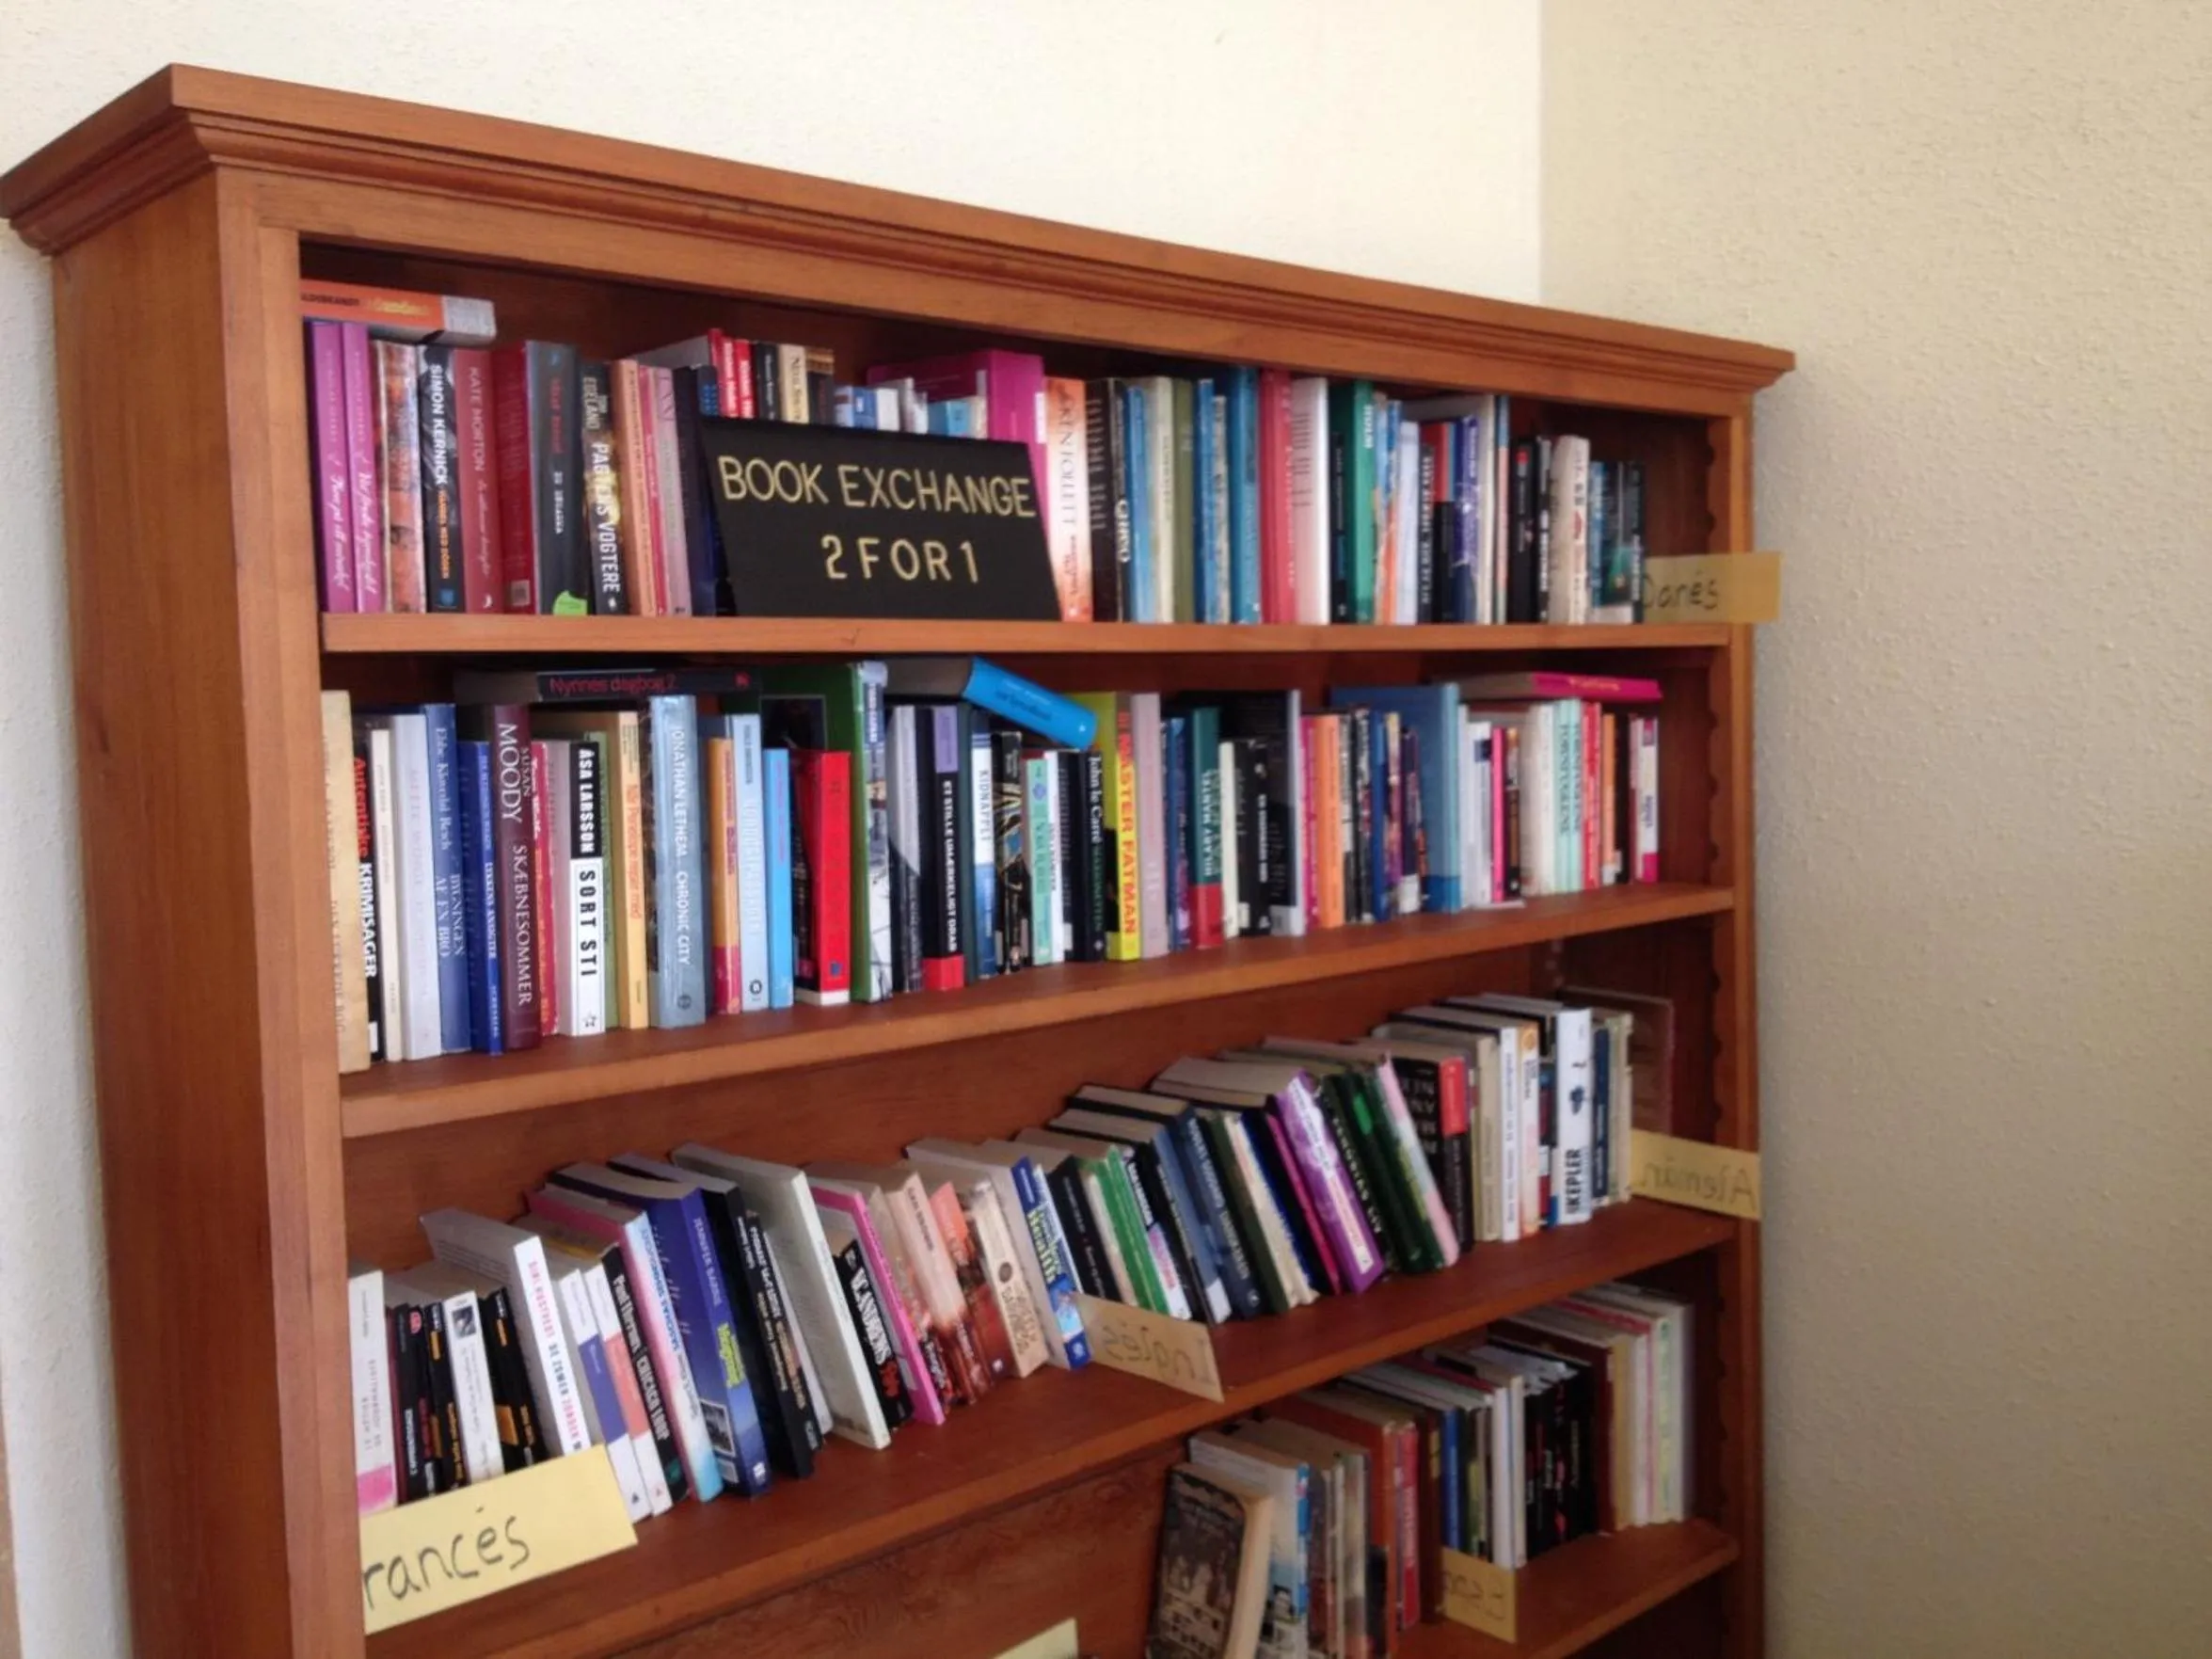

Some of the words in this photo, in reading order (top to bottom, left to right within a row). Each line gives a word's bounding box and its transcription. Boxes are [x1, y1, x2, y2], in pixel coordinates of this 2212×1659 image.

[428, 364, 444, 418] SIMON
[468, 367, 481, 403] KATE
[582, 376, 601, 430] EGELAND
[431, 420, 448, 486] KERNICK
[472, 408, 485, 471] MORTON
[717, 455, 829, 505] BOOK
[837, 464, 1036, 518] EXCHANGE
[597, 520, 621, 594] VOGTERE
[820, 534, 848, 580] 2
[856, 536, 951, 582] FOR
[960, 541, 979, 583] 1
[498, 723, 522, 824] MOODY
[520, 747, 531, 798] SUSAN
[578, 748, 592, 778] ÅSA
[671, 726, 687, 799] JONATHAN
[1089, 756, 1101, 788] John
[1119, 733, 1136, 833] MASTER
[580, 781, 594, 853] LARSSON
[979, 769, 992, 842] KIDNAPPET
[1090, 790, 1101, 803] le
[1090, 806, 1103, 843] Carré
[674, 801, 689, 858] LETHEM
[579, 869, 598, 925] SORT
[675, 870, 689, 930] CHRONIC
[1122, 839, 1138, 934] FATMAN
[359, 863, 375, 978] KRIMISAGER
[512, 845, 533, 1006] SKÆBNESOMMER
[676, 933, 691, 966] CITY
[580, 939, 598, 978] STI
[1566, 1148, 1583, 1206] KEPLER
[553, 1360, 569, 1396] ZOMER
[361, 1506, 531, 1609] rancés
